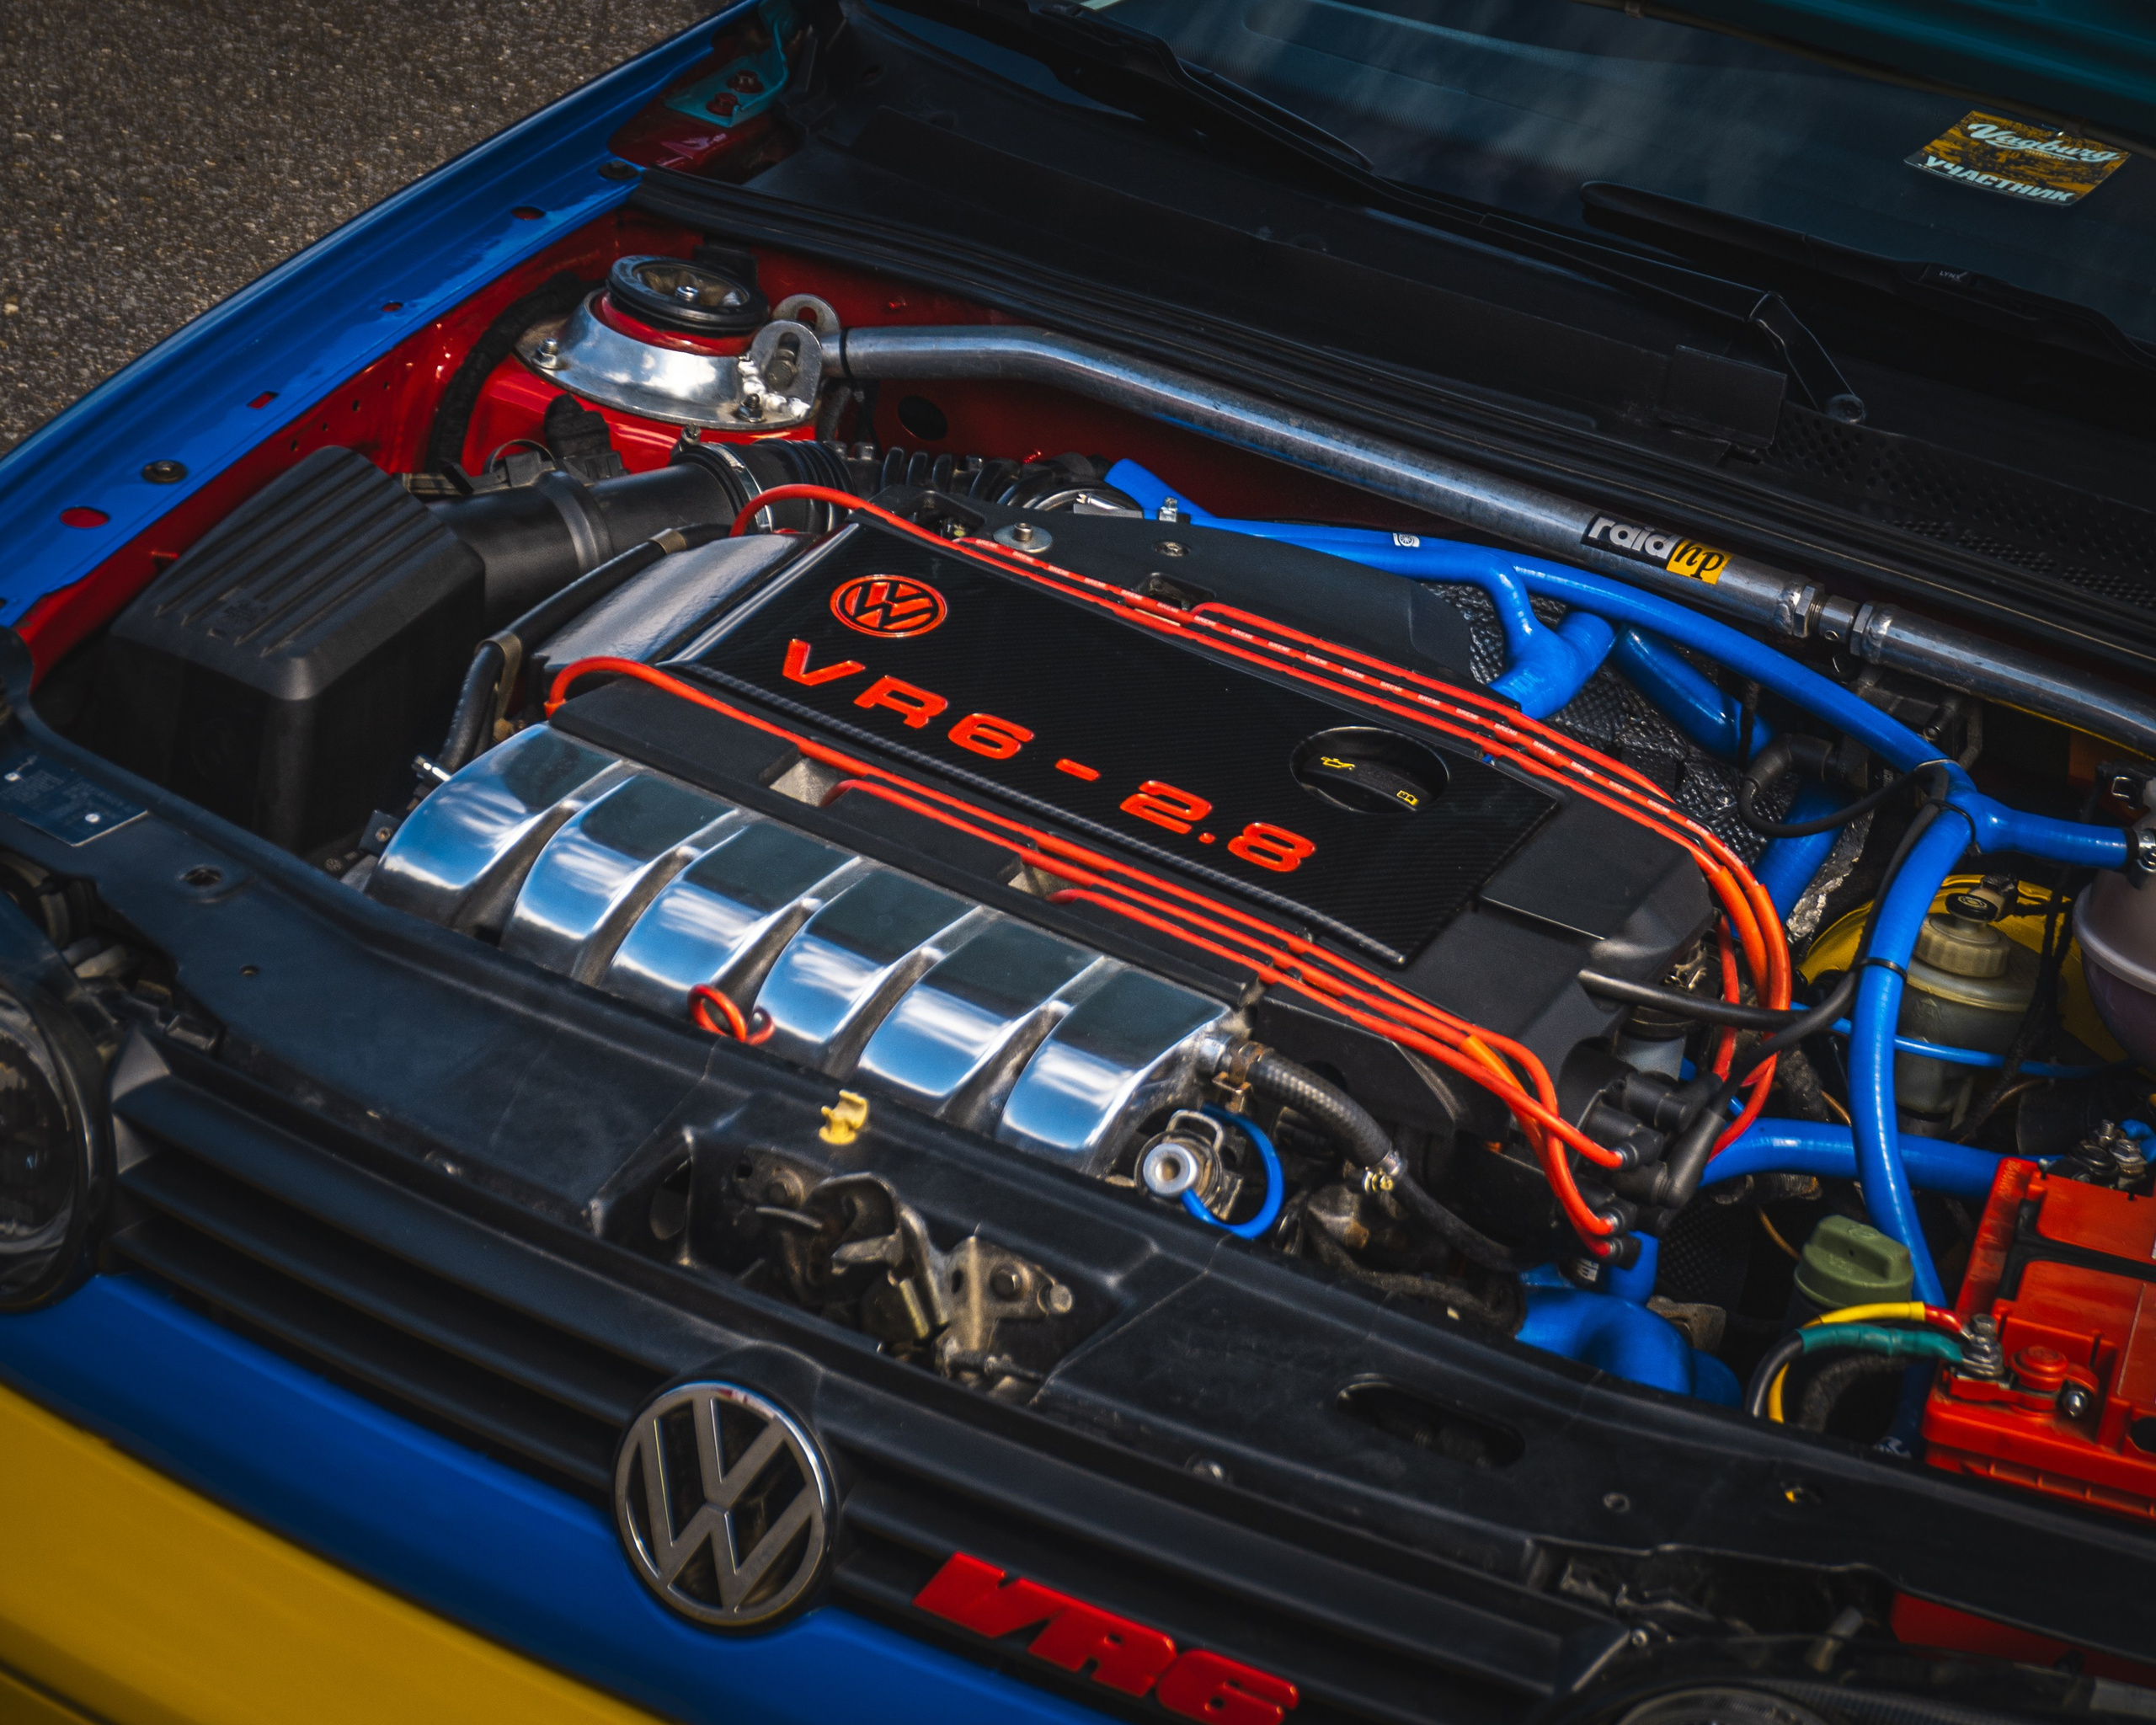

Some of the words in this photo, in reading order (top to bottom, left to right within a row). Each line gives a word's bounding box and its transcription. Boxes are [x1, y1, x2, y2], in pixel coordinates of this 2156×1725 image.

[1968, 123, 2121, 163] Vagburg
[1925, 154, 2075, 202] УЧАСТНИК
[1939, 270, 1968, 282] LYNX
[1588, 515, 1684, 560] raid
[1193, 615, 1216, 628] BREMI
[1230, 628, 1253, 641] BREMI
[1267, 641, 1290, 654] BREMI
[1305, 654, 1327, 666] BREMI
[1342, 667, 1365, 680] BREMI
[1380, 681, 1402, 692] BREMI
[1417, 694, 1441, 707] BREMI
[1455, 708, 1479, 721] BREMI
[1494, 723, 1518, 736] BREMI
[1533, 740, 1556, 756] BREMI
[1571, 761, 1594, 777] BREMI
[1608, 780, 1631, 795] BREMI
[782, 638, 1035, 760] VR6
[1119, 780, 1317, 873] 2.8
[912, 1551, 1299, 1725] VR6
